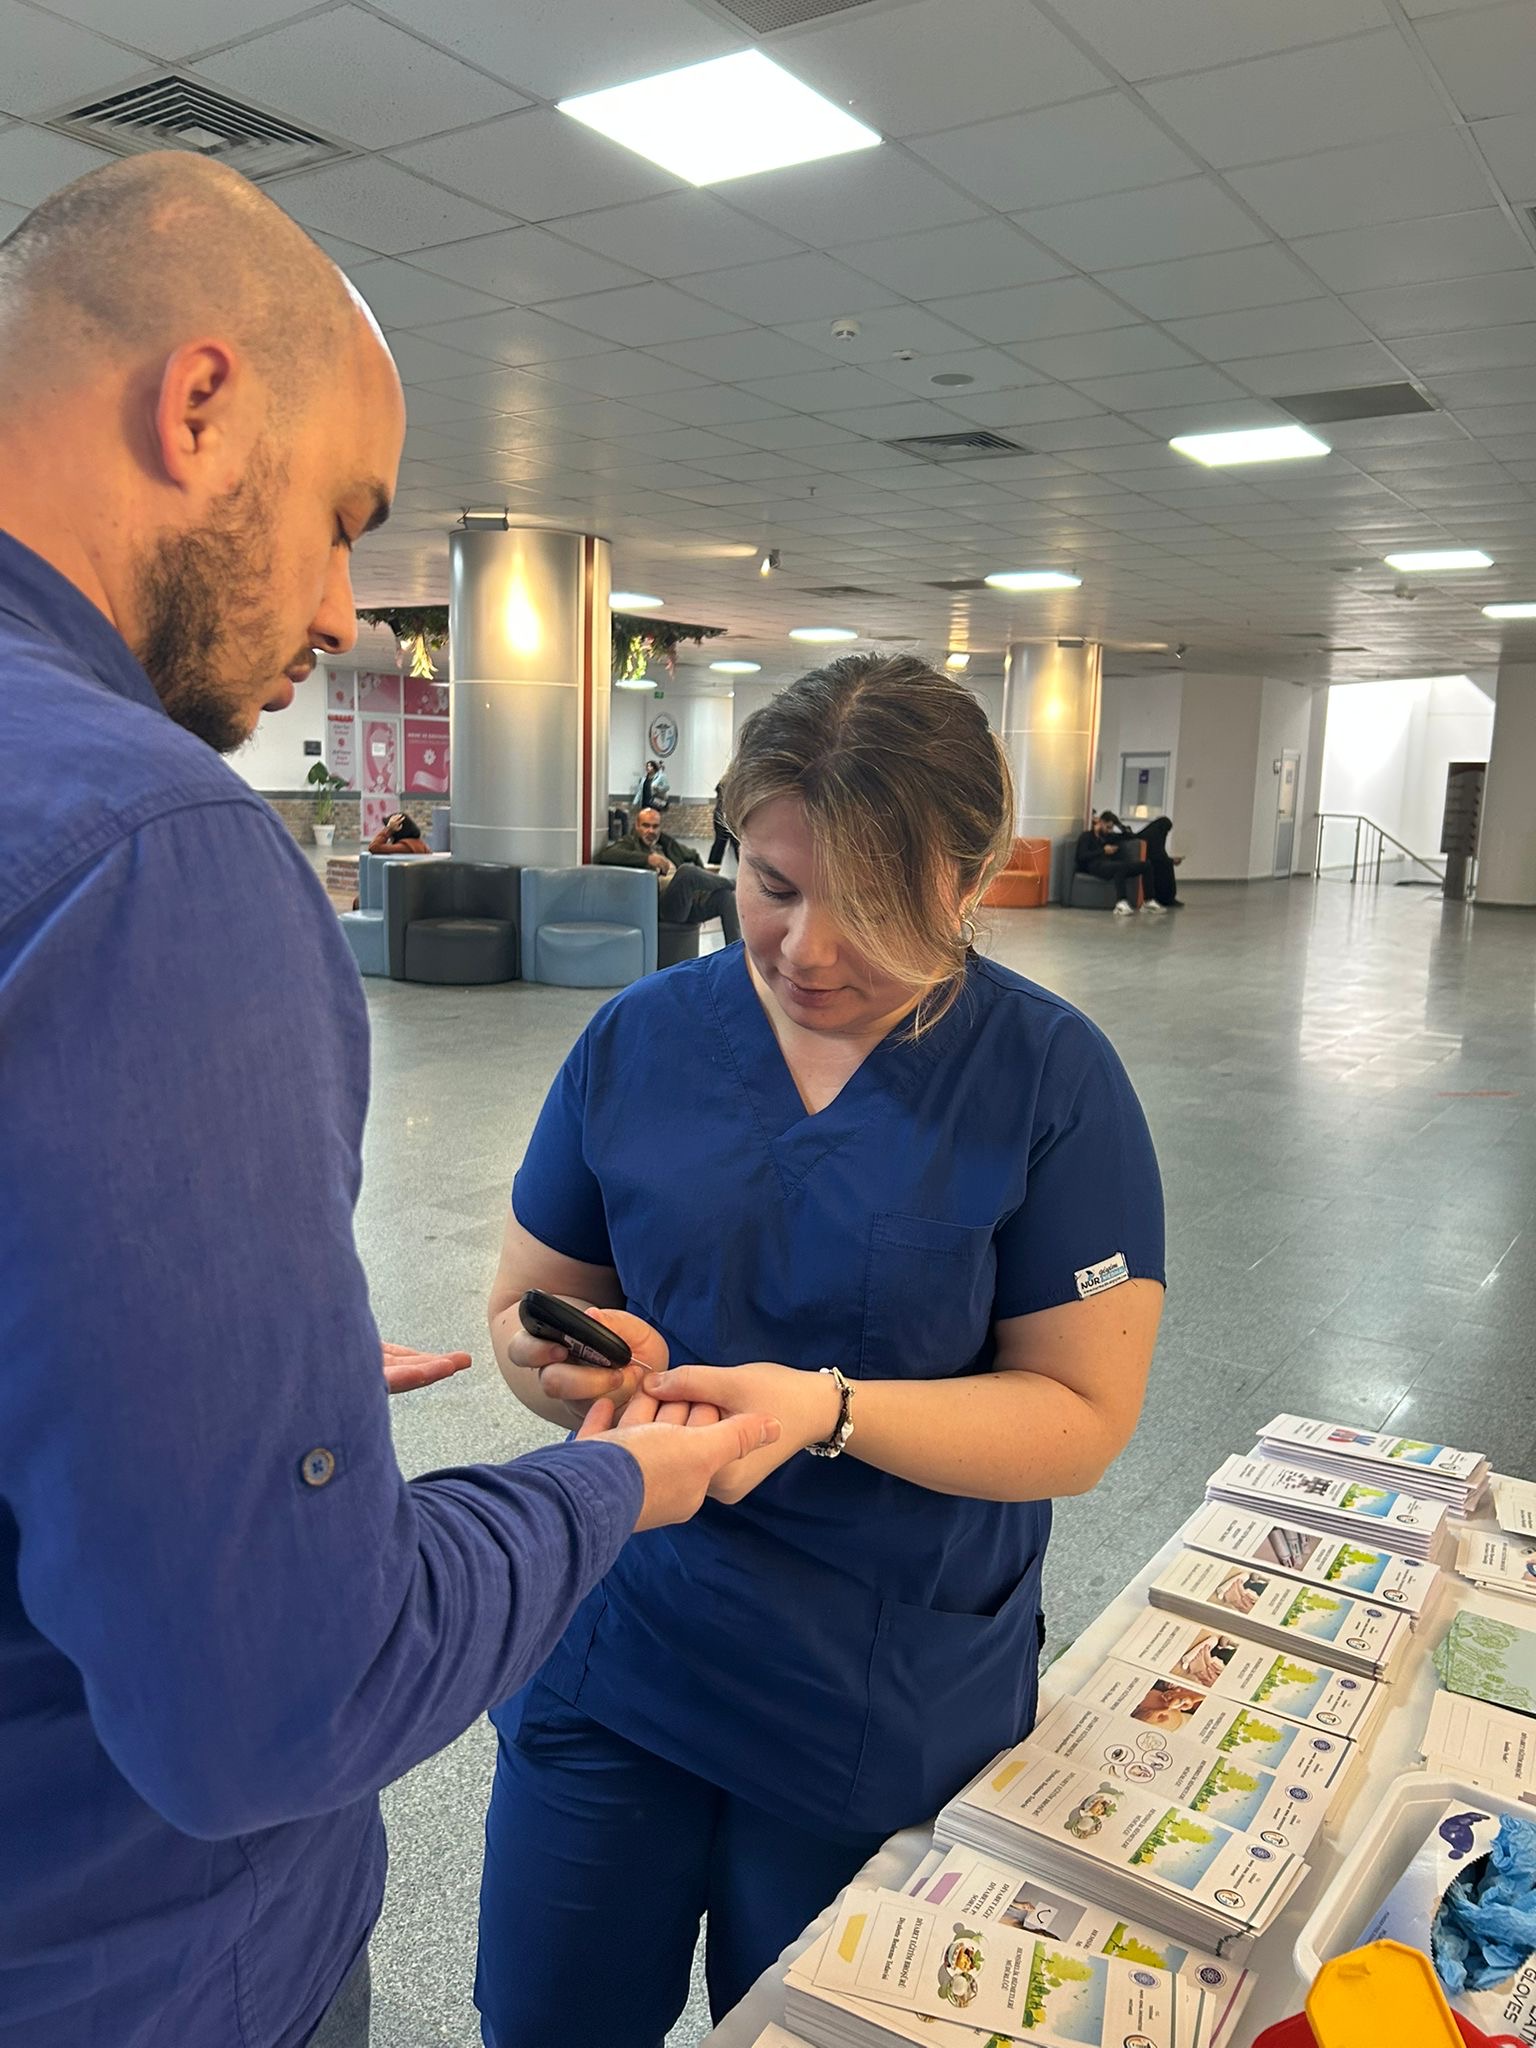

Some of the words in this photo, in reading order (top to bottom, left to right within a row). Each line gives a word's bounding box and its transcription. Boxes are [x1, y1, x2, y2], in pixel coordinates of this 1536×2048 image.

[1080, 1277, 1100, 1289] NUR
[972, 1880, 997, 1911] DİYABETTE
[990, 1882, 1010, 1906] DİYABET
[981, 1904, 995, 1919] EĞİT
[893, 1916, 906, 1938] Diyabette
[910, 1917, 924, 1940] DİYABET
[887, 1937, 899, 1959] Beslenme
[905, 1939, 918, 1961] EĞİTİM
[881, 1959, 893, 1980] Tedavisi
[1501, 1966, 1536, 2023] GLOVES
